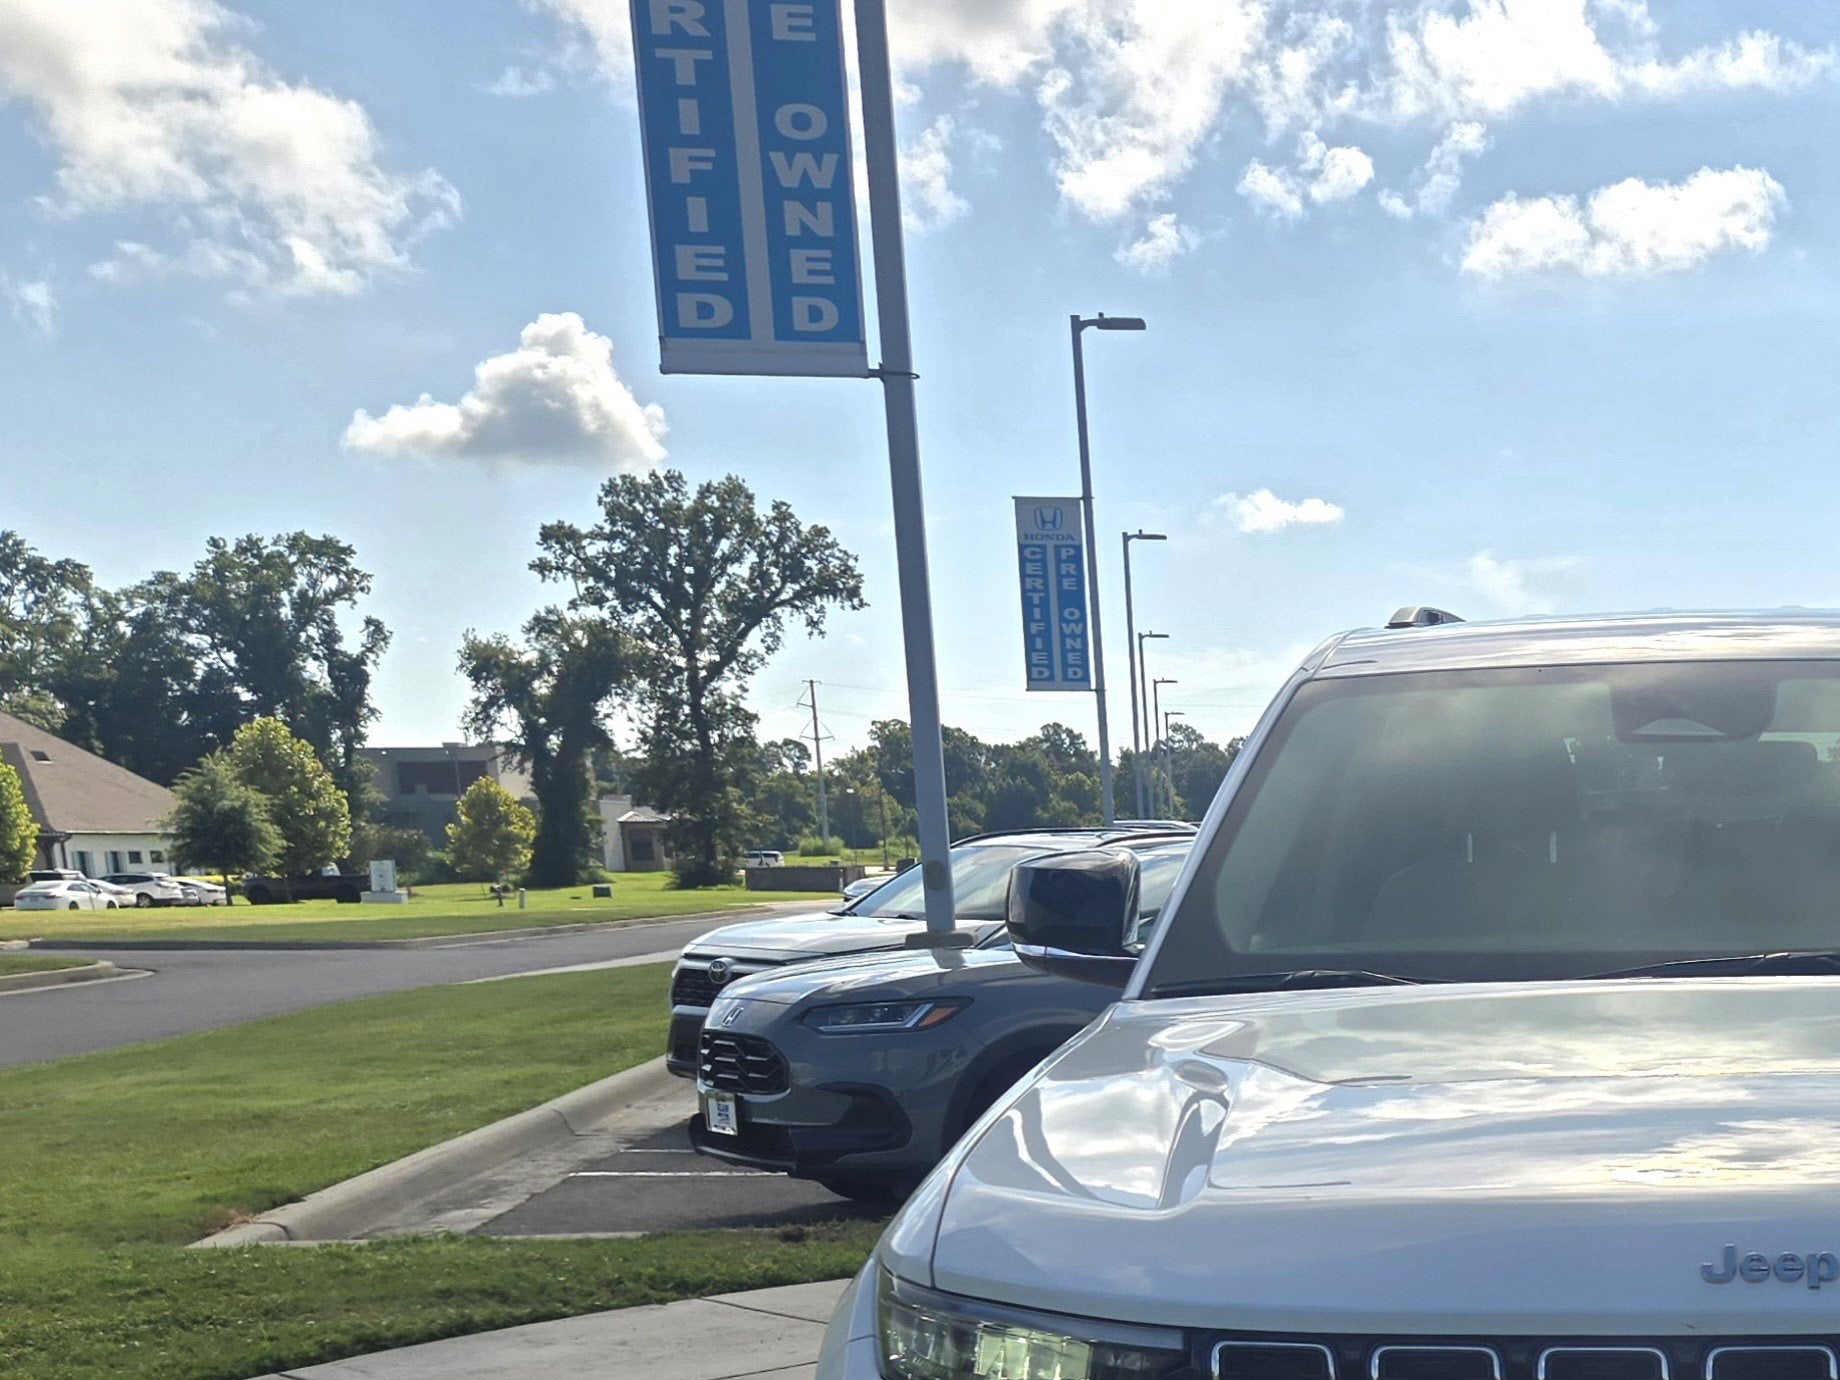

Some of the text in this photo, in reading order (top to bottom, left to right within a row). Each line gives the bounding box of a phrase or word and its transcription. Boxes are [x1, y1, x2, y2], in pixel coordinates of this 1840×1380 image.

[768, 103, 840, 333] OWNED
[1023, 532, 1076, 542] HONDA
[1023, 546, 1050, 680] CERTIFIED
[1060, 547, 1084, 680] PRE OWNED
[1701, 1243, 1840, 1290] Jeep
